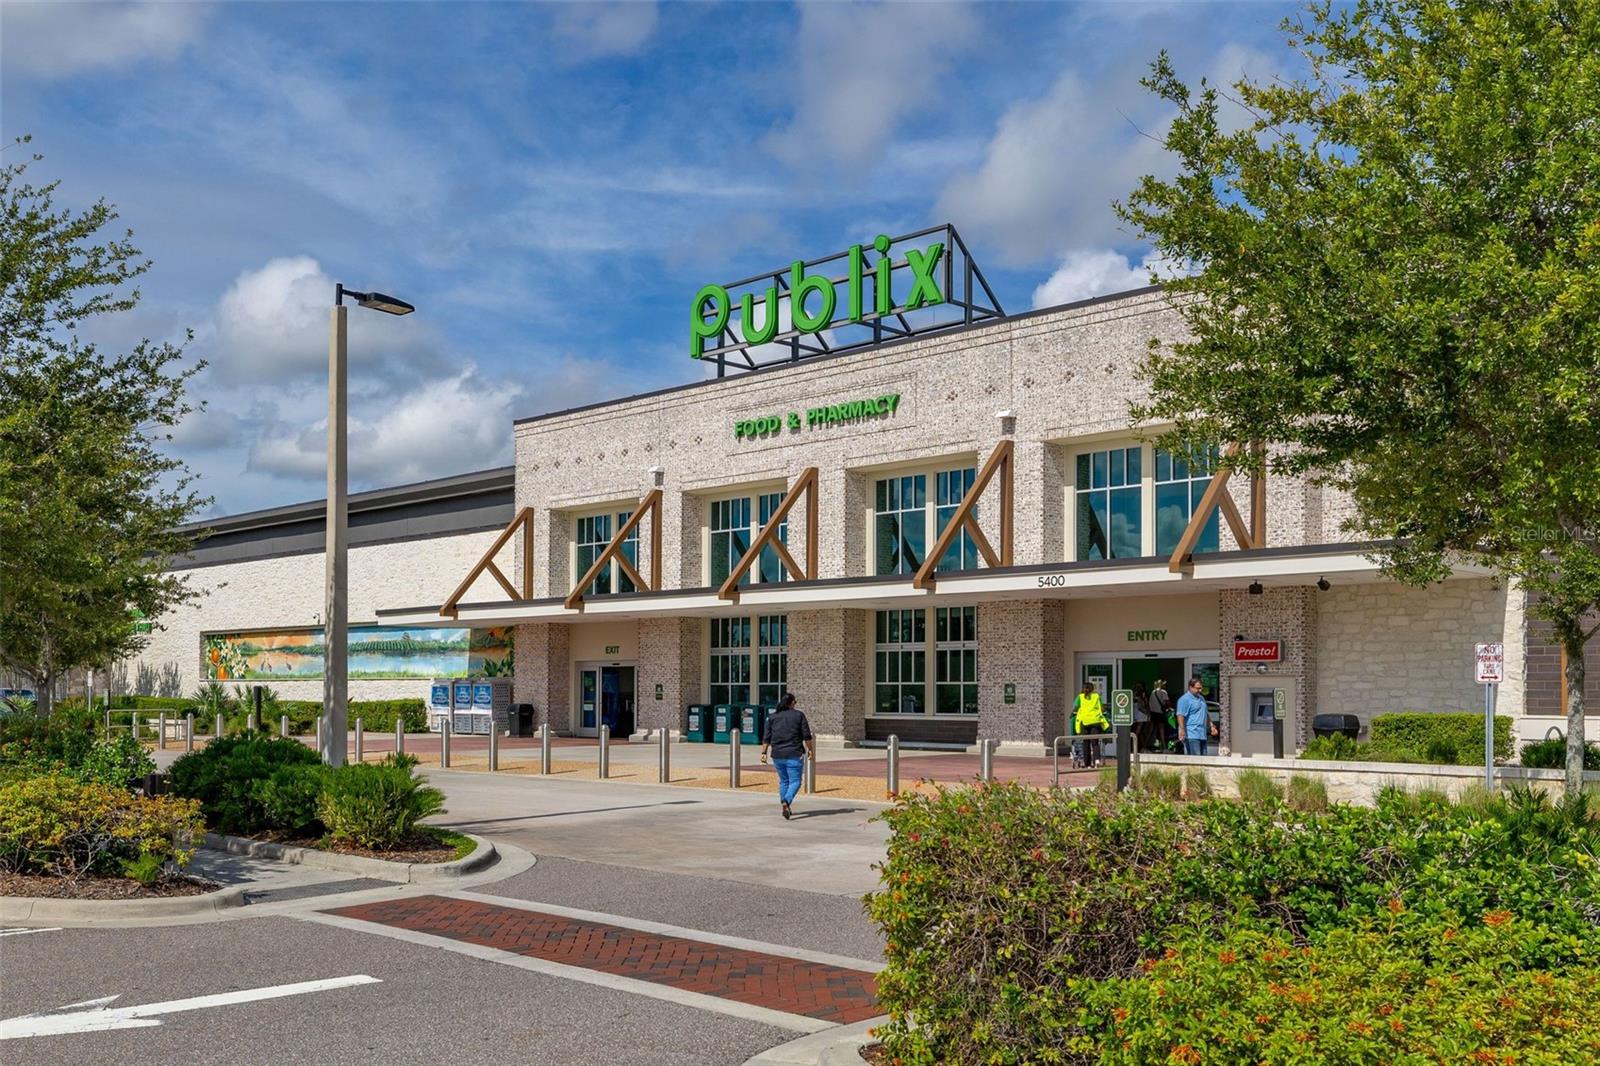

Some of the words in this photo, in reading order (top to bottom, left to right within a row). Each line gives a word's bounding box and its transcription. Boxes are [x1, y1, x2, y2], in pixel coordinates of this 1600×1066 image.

[734, 416, 781, 437] FOOD
[787, 412, 801, 429] &
[806, 394, 900, 424] PHARMACY
[1038, 575, 1066, 588] 5400
[1127, 630, 1168, 642] ENTRY
[605, 645, 620, 654] EXIT
[1237, 646, 1276, 656] Presto!
[1484, 645, 1496, 654] NO
[1477, 655, 1503, 663] PARKING
